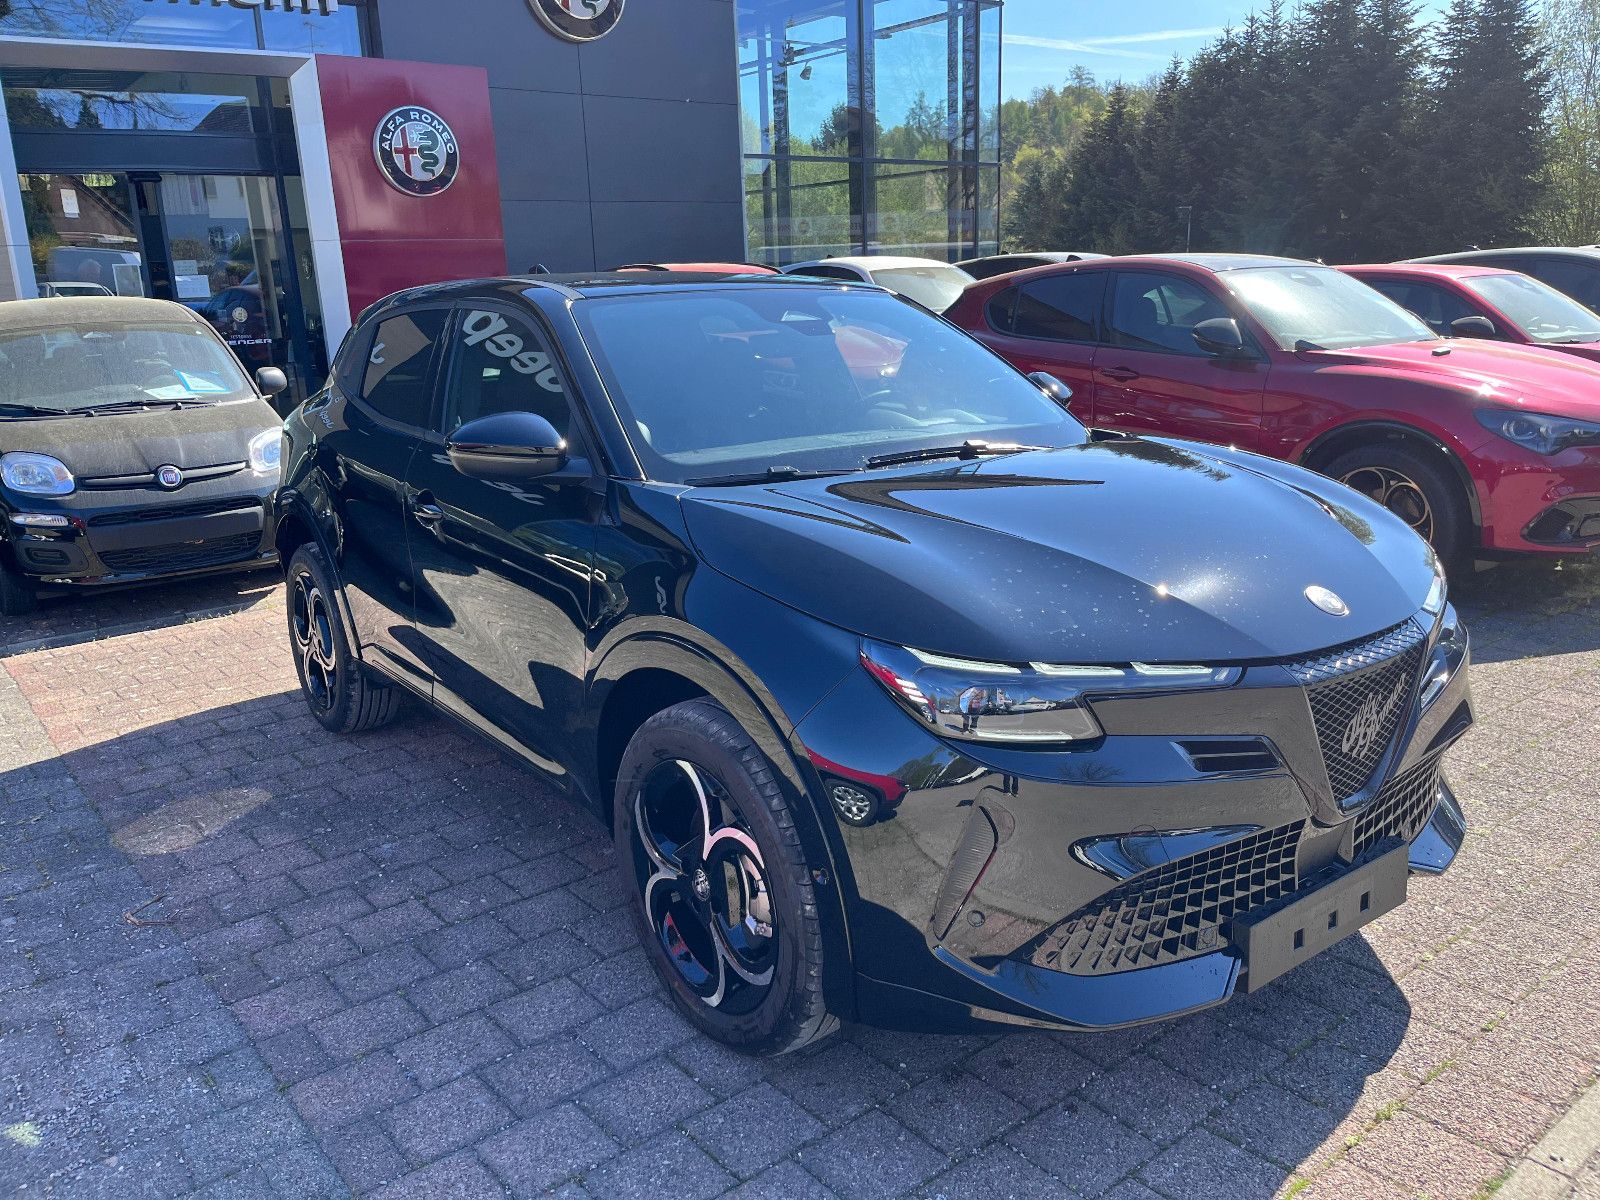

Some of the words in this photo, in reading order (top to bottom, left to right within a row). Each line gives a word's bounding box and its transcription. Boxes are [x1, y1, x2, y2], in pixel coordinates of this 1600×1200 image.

[382, 115, 404, 151] ALFA
[410, 111, 455, 153] ROMEO
[226, 338, 272, 346] ENGER
